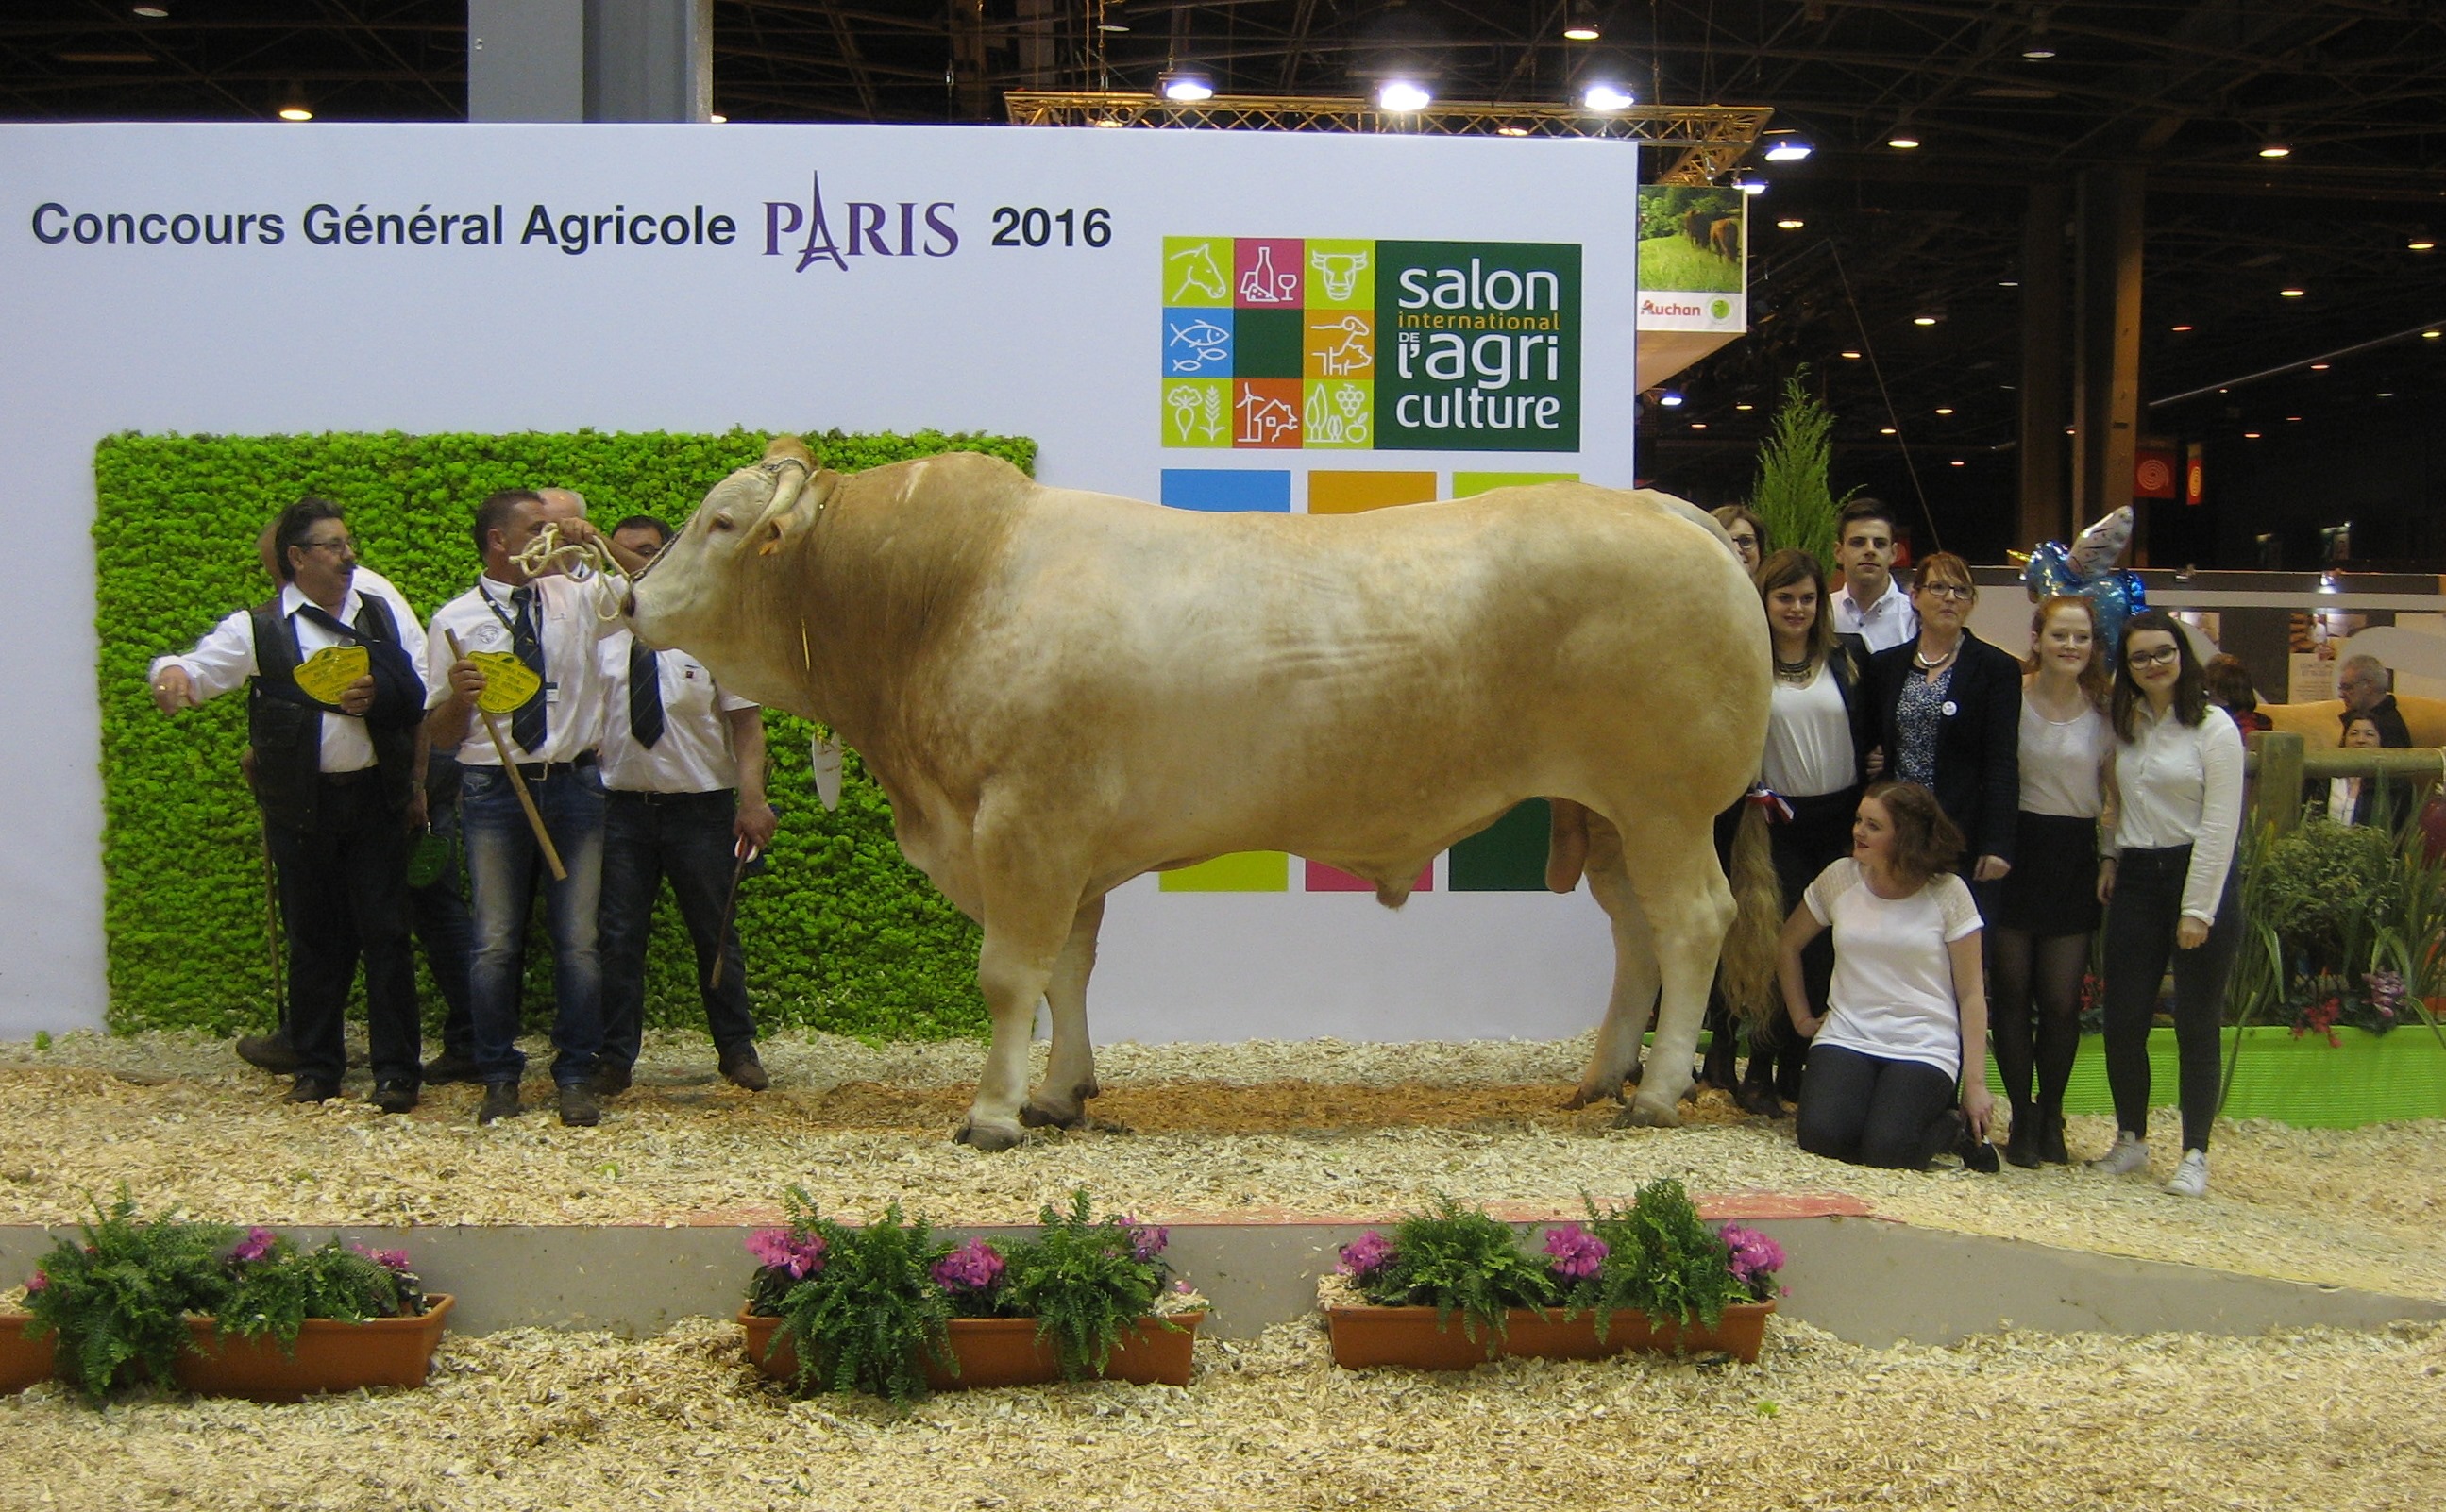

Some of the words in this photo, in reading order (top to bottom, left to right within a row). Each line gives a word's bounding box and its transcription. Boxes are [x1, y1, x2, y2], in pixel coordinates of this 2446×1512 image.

[32, 202, 285, 245] Concours
[303, 203, 503, 245] Général
[520, 204, 736, 256] Agricole
[763, 170, 959, 274] PARIS
[992, 206, 1112, 248] 2016
[1398, 258, 1559, 311] salon
[1398, 311, 1560, 330] international
[1641, 299, 1702, 317] Auchan
[1398, 332, 1421, 344] DE
[1396, 387, 1560, 429] culture
